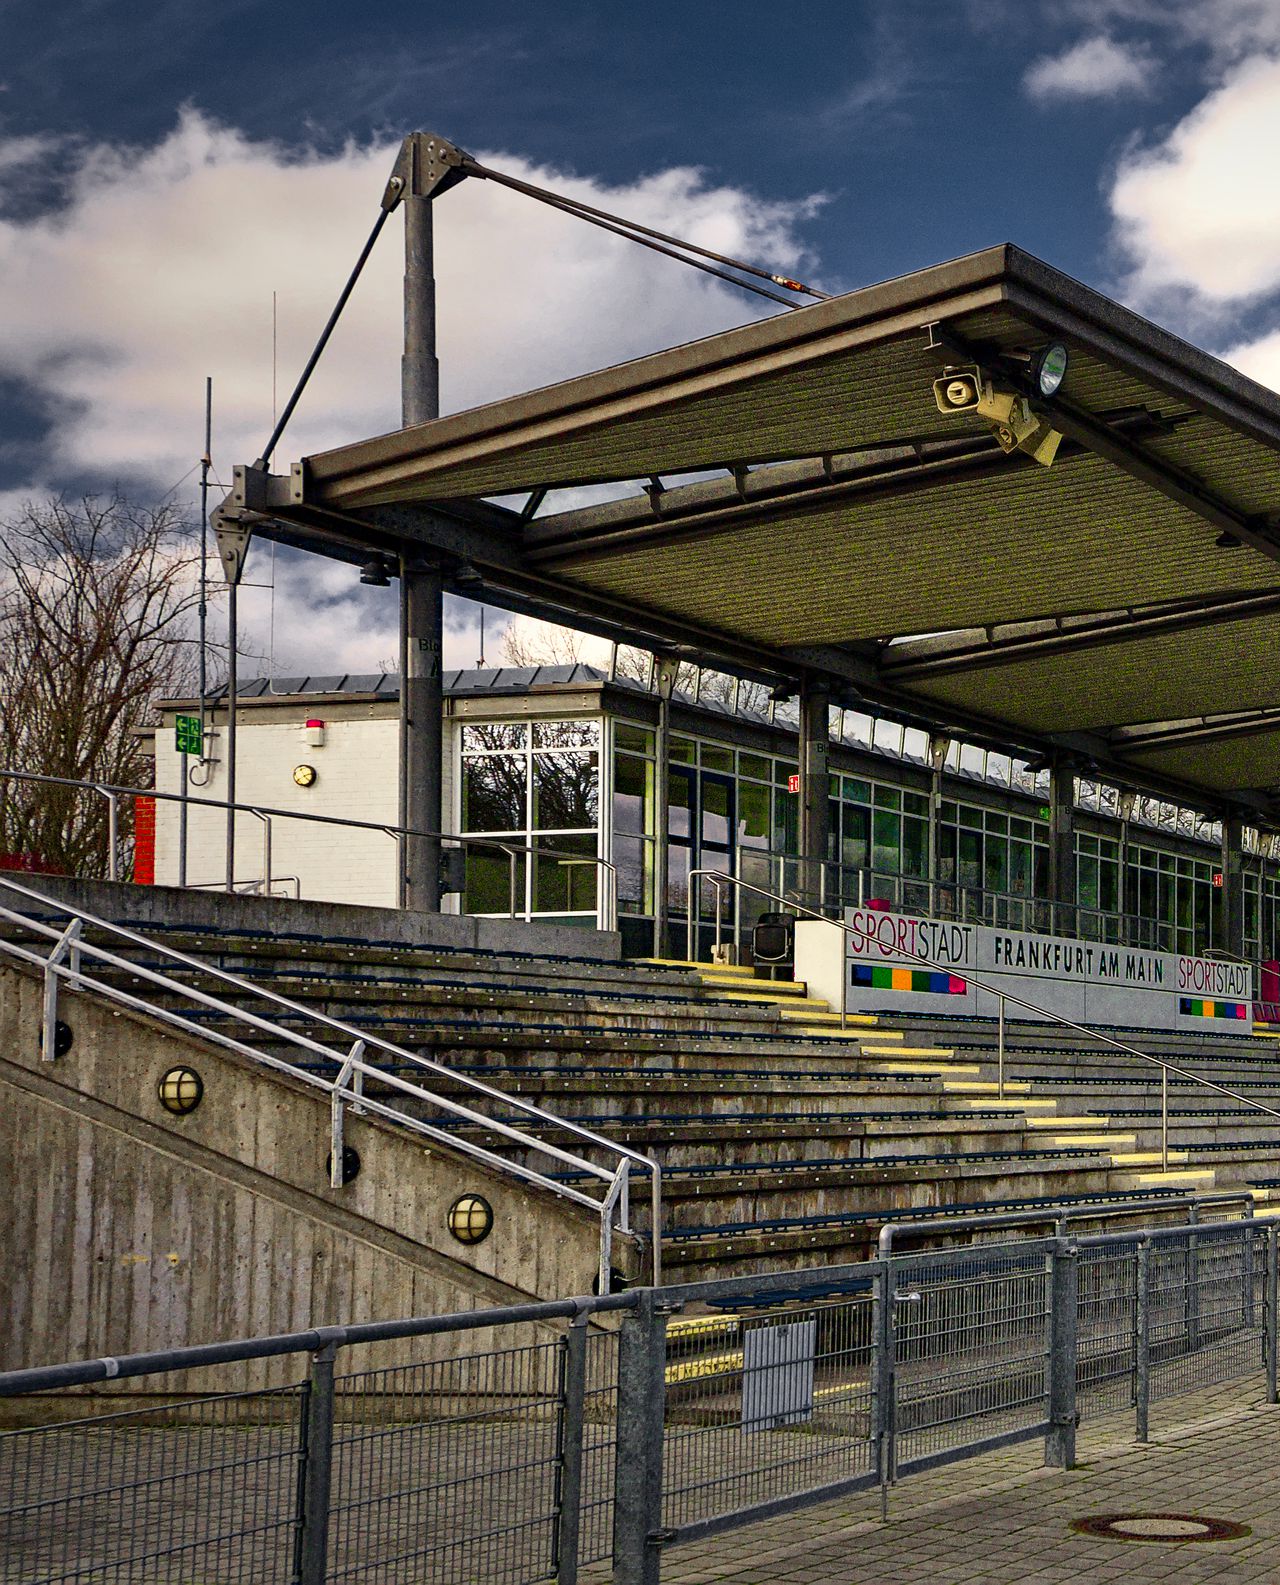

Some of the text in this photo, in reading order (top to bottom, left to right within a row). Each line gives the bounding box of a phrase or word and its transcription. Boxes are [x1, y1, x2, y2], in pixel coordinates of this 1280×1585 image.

[851, 911, 972, 964] SPORTSTADT
[994, 936, 1163, 984] FRANKFURT AM MAIN
[1178, 957, 1249, 996] SPORTSTADT
